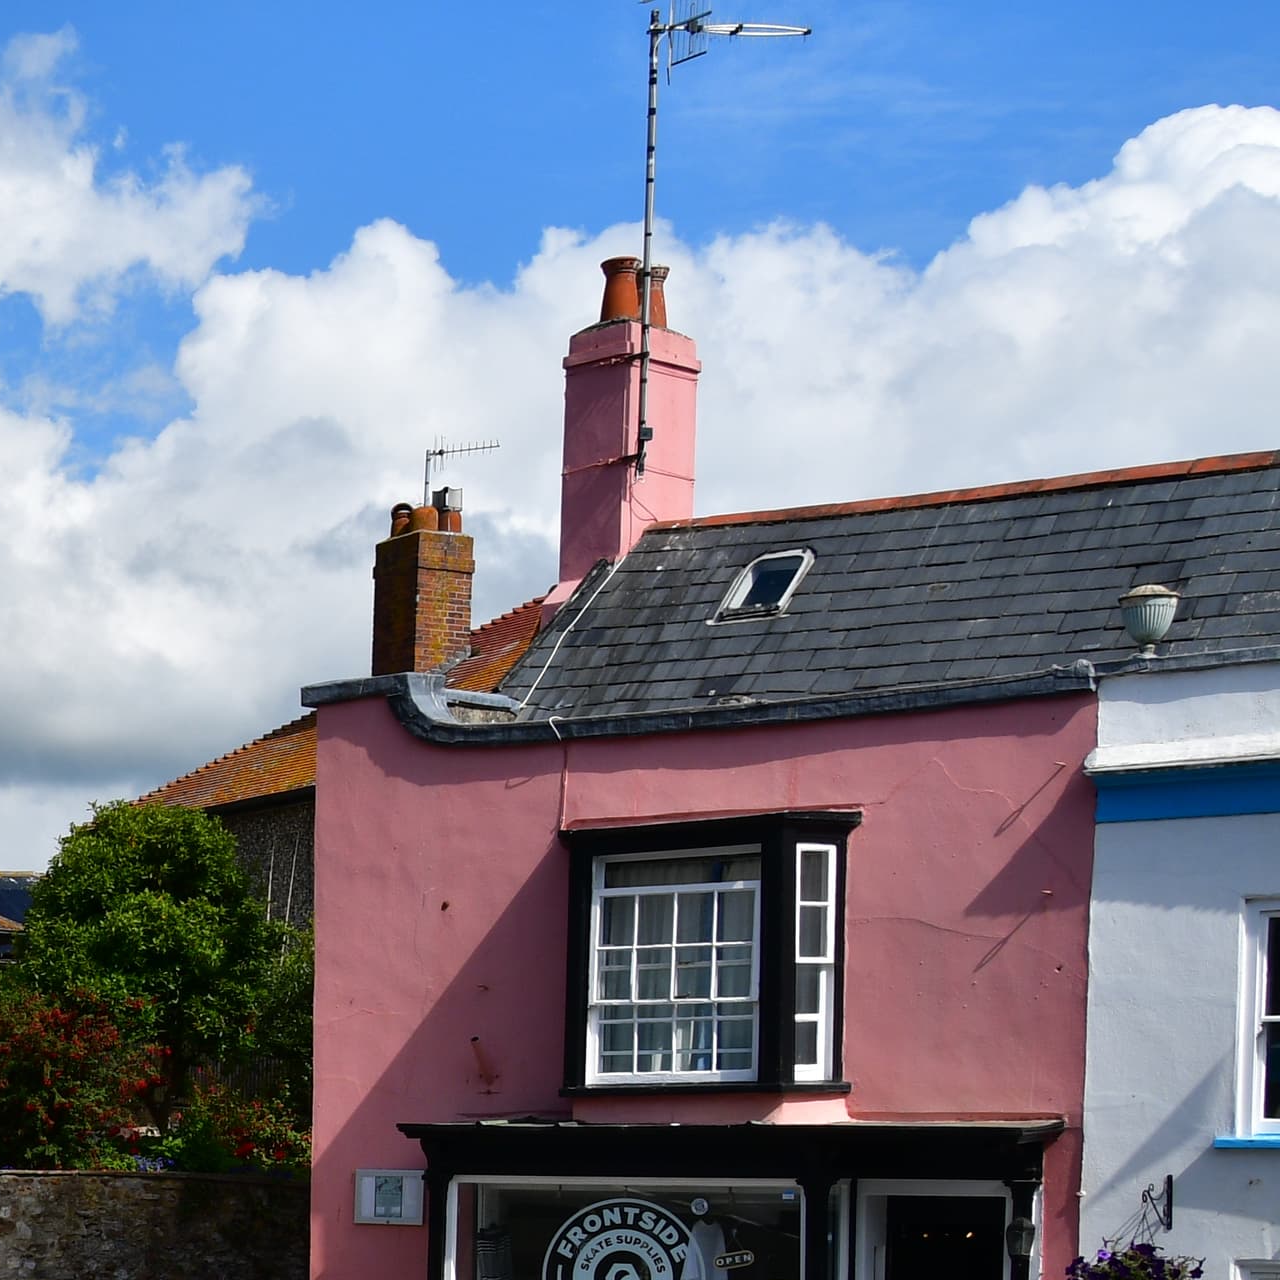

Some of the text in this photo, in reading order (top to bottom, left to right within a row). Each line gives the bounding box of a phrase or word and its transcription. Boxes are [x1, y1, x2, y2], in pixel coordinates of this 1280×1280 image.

[558, 1206, 688, 1264] FRONTSIDE
[580, 1234, 666, 1273] SKATE SUPPLIES
[716, 1254, 752, 1266] OPEN
